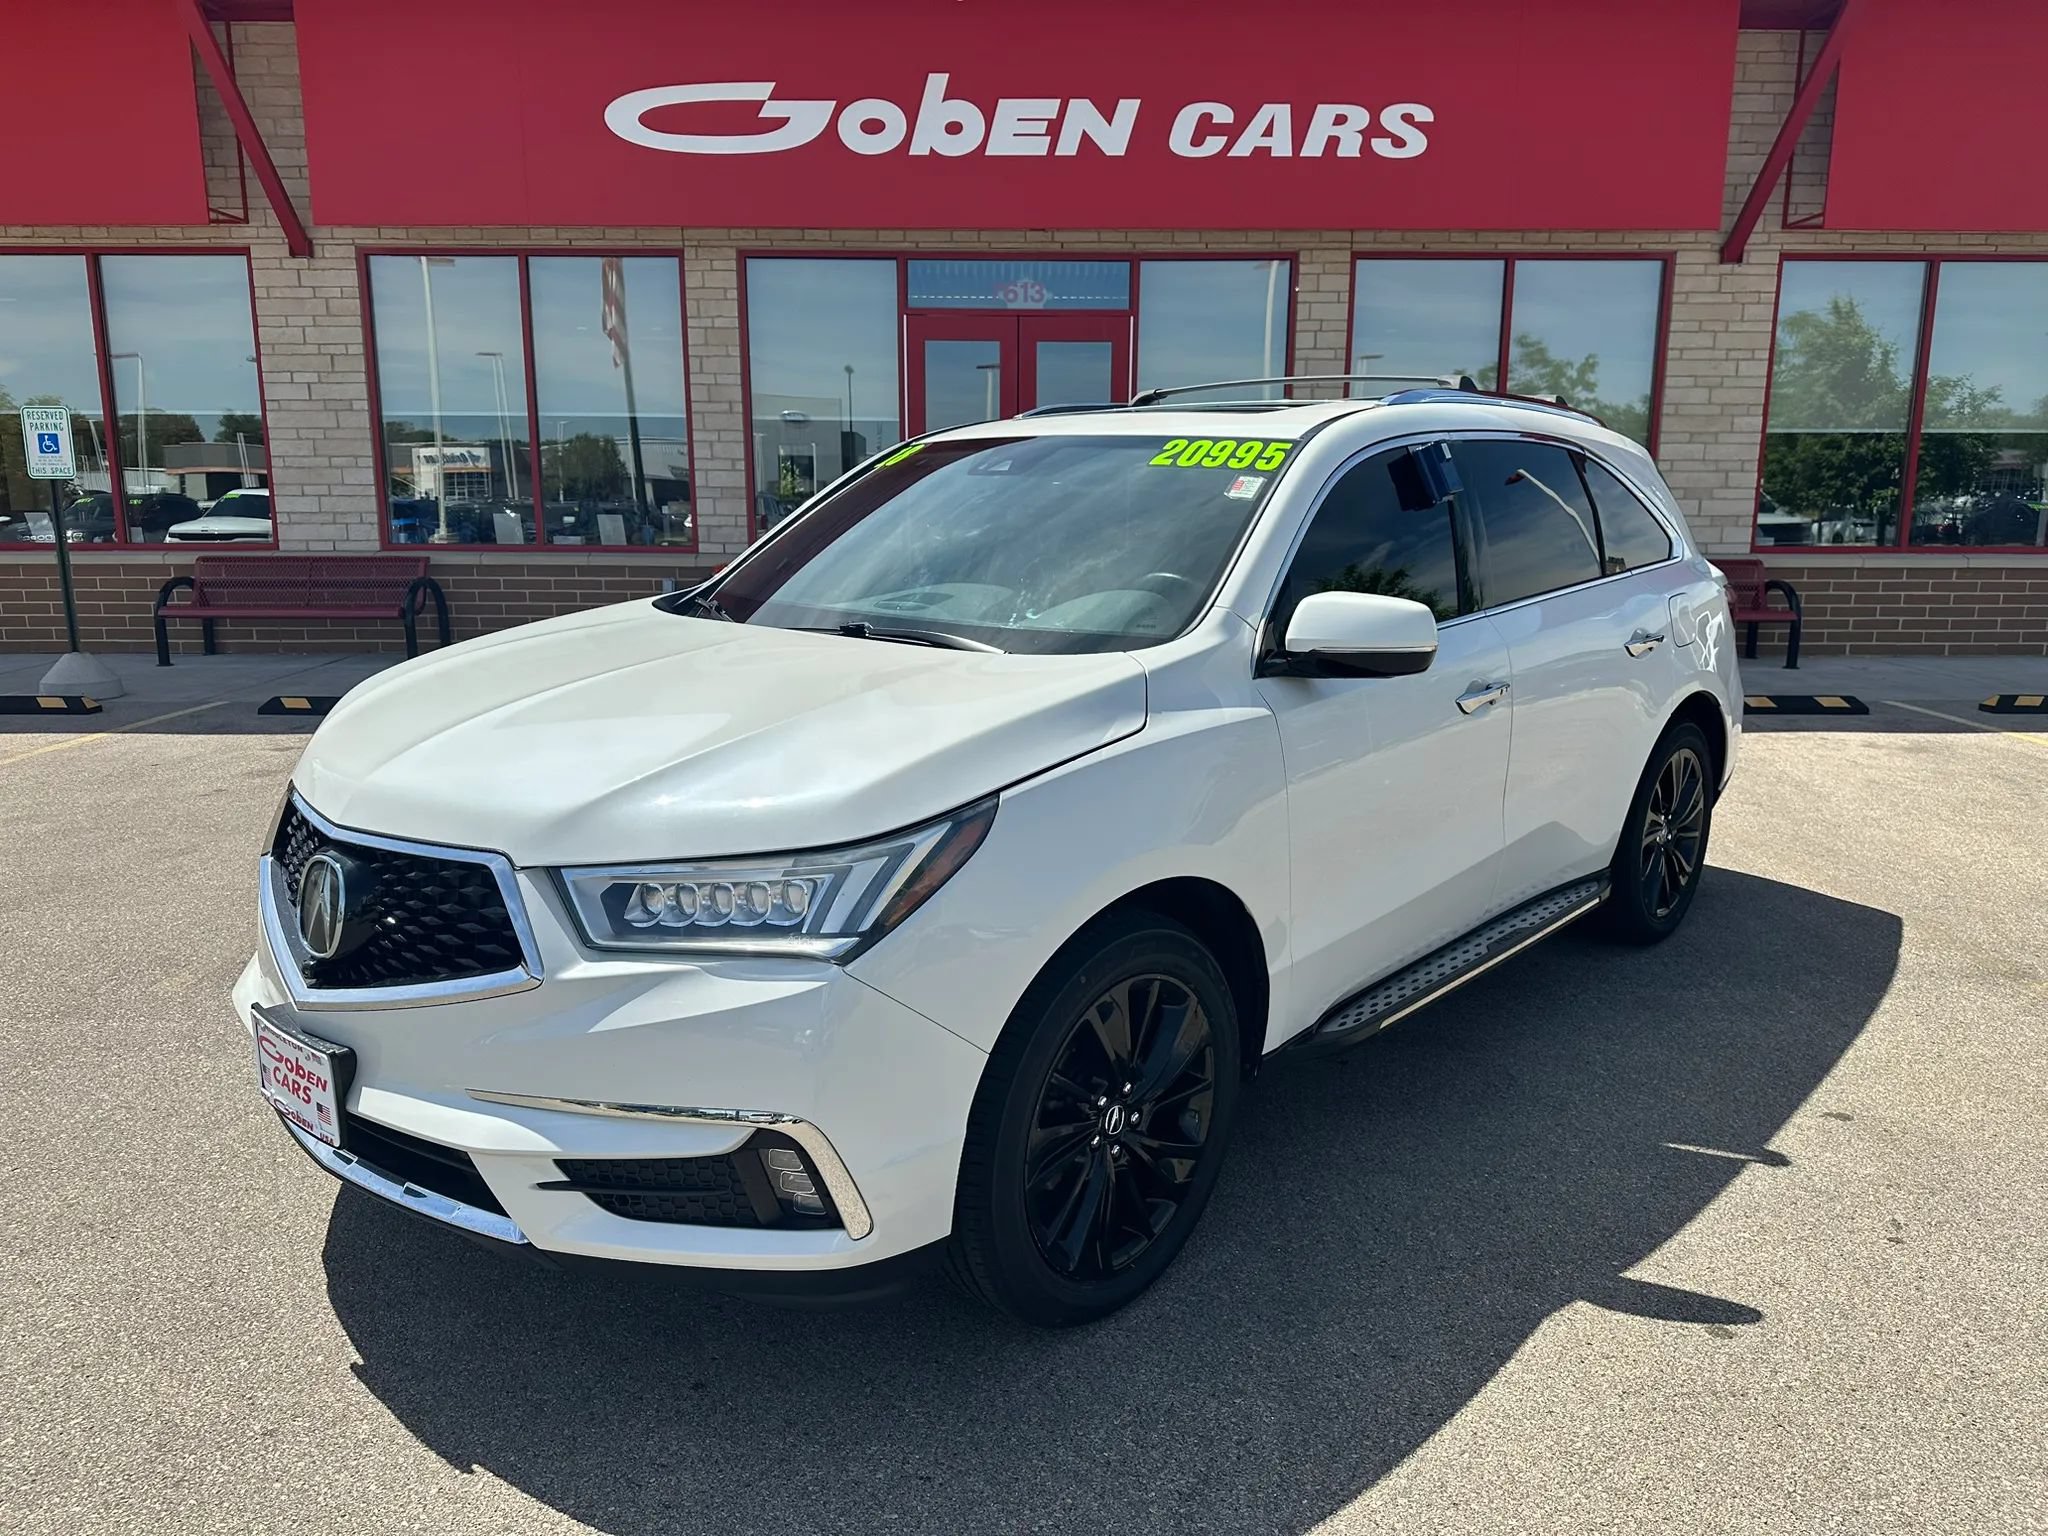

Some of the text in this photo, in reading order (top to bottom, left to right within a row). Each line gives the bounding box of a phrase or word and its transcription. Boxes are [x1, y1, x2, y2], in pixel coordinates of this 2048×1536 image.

[1168, 102, 1435, 159] CARS
[1004, 281, 1045, 304] 613
[26, 410, 64, 420] RESERVED
[29, 422, 64, 432] PARKING
[1148, 438, 1294, 471] 20995
[32, 466, 72, 475] THIS SPACE
[273, 1066, 312, 1105] CARS
